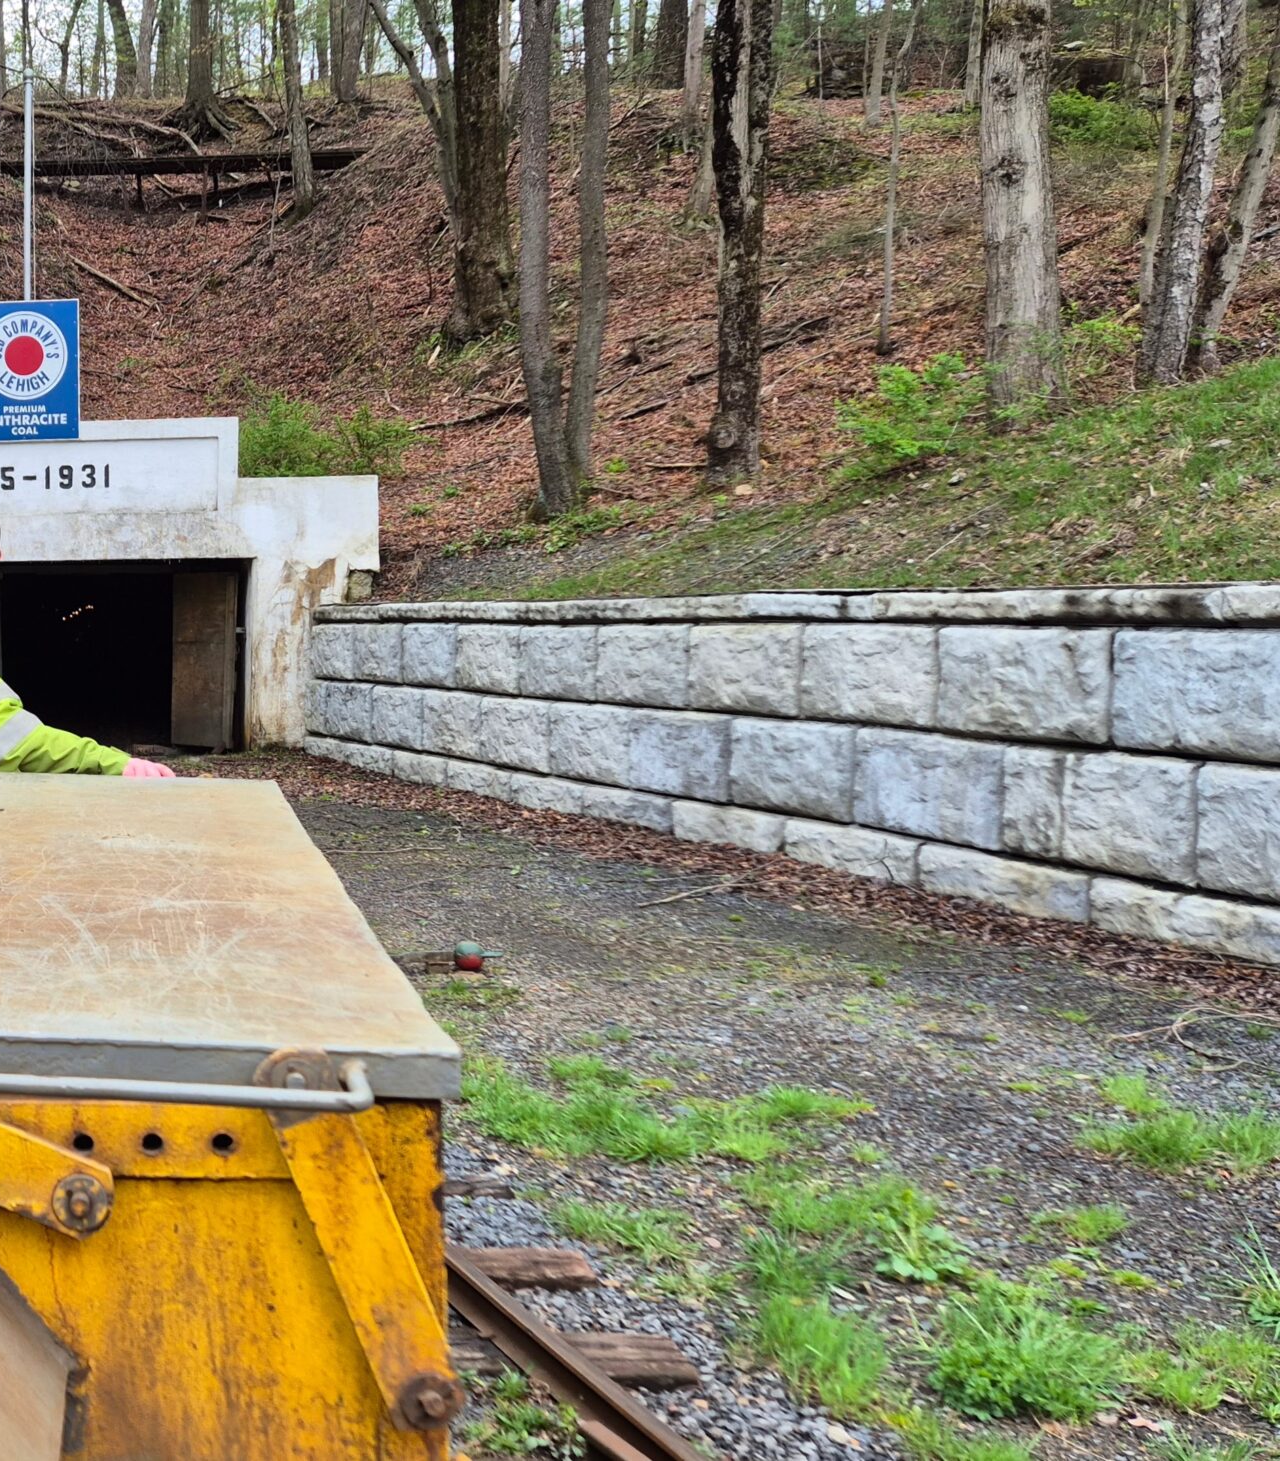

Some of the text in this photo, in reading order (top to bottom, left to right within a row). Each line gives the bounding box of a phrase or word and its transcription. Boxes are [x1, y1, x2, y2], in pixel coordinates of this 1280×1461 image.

[3, 319, 59, 359] COMPANY'S
[0, 371, 50, 391] LEHIGH
[3, 405, 46, 413] PREMIUM
[11, 427, 38, 435] COAL
